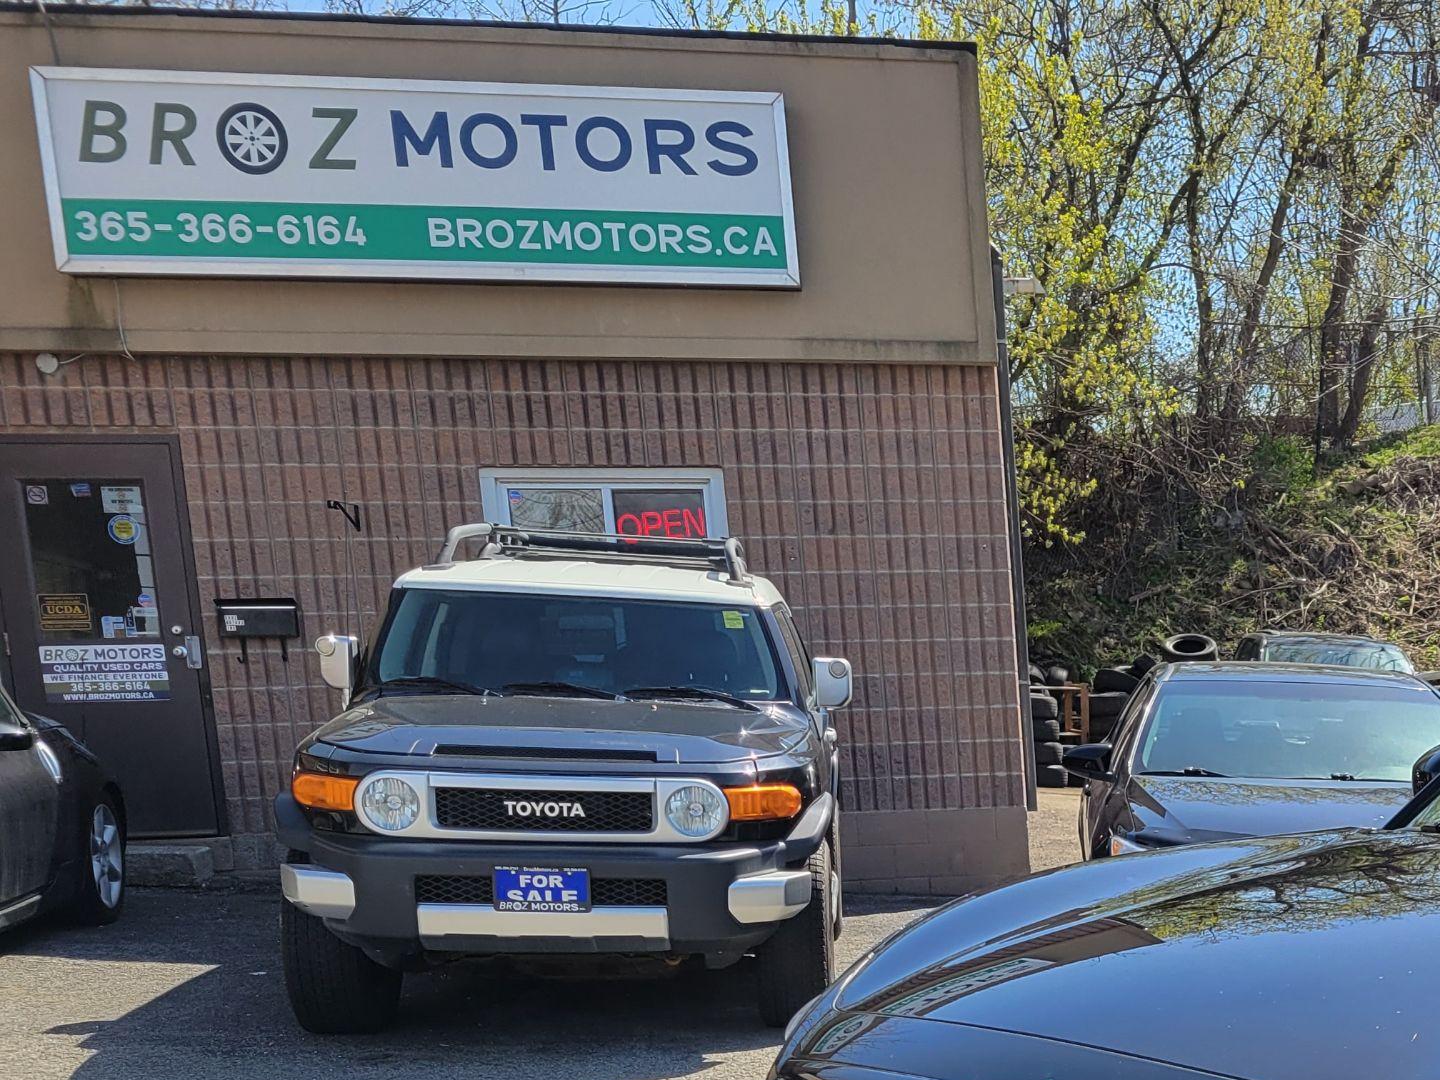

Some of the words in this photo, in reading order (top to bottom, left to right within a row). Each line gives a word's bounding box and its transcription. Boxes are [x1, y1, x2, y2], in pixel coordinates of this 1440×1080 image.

[78, 100, 358, 175] BROZ
[389, 109, 759, 178] MOTORS
[74, 210, 368, 247] 365-366-6164
[426, 218, 779, 258] BROZMOTORS.CA
[616, 507, 706, 544] OPEN
[45, 605, 83, 614] UCDA
[94, 647, 164, 660] MOTORS
[53, 663, 98, 673] QUALITY
[101, 662, 131, 671] USED
[133, 662, 163, 670] CARS
[50, 674, 65, 682] WE
[68, 673, 110, 681] FINANCE
[113, 672, 164, 680] EVERYONE
[70, 681, 151, 692] 365-366-6164
[503, 800, 586, 818] TOYOTA
[519, 874, 564, 888] FOR
[531, 902, 579, 911] MOTORS
